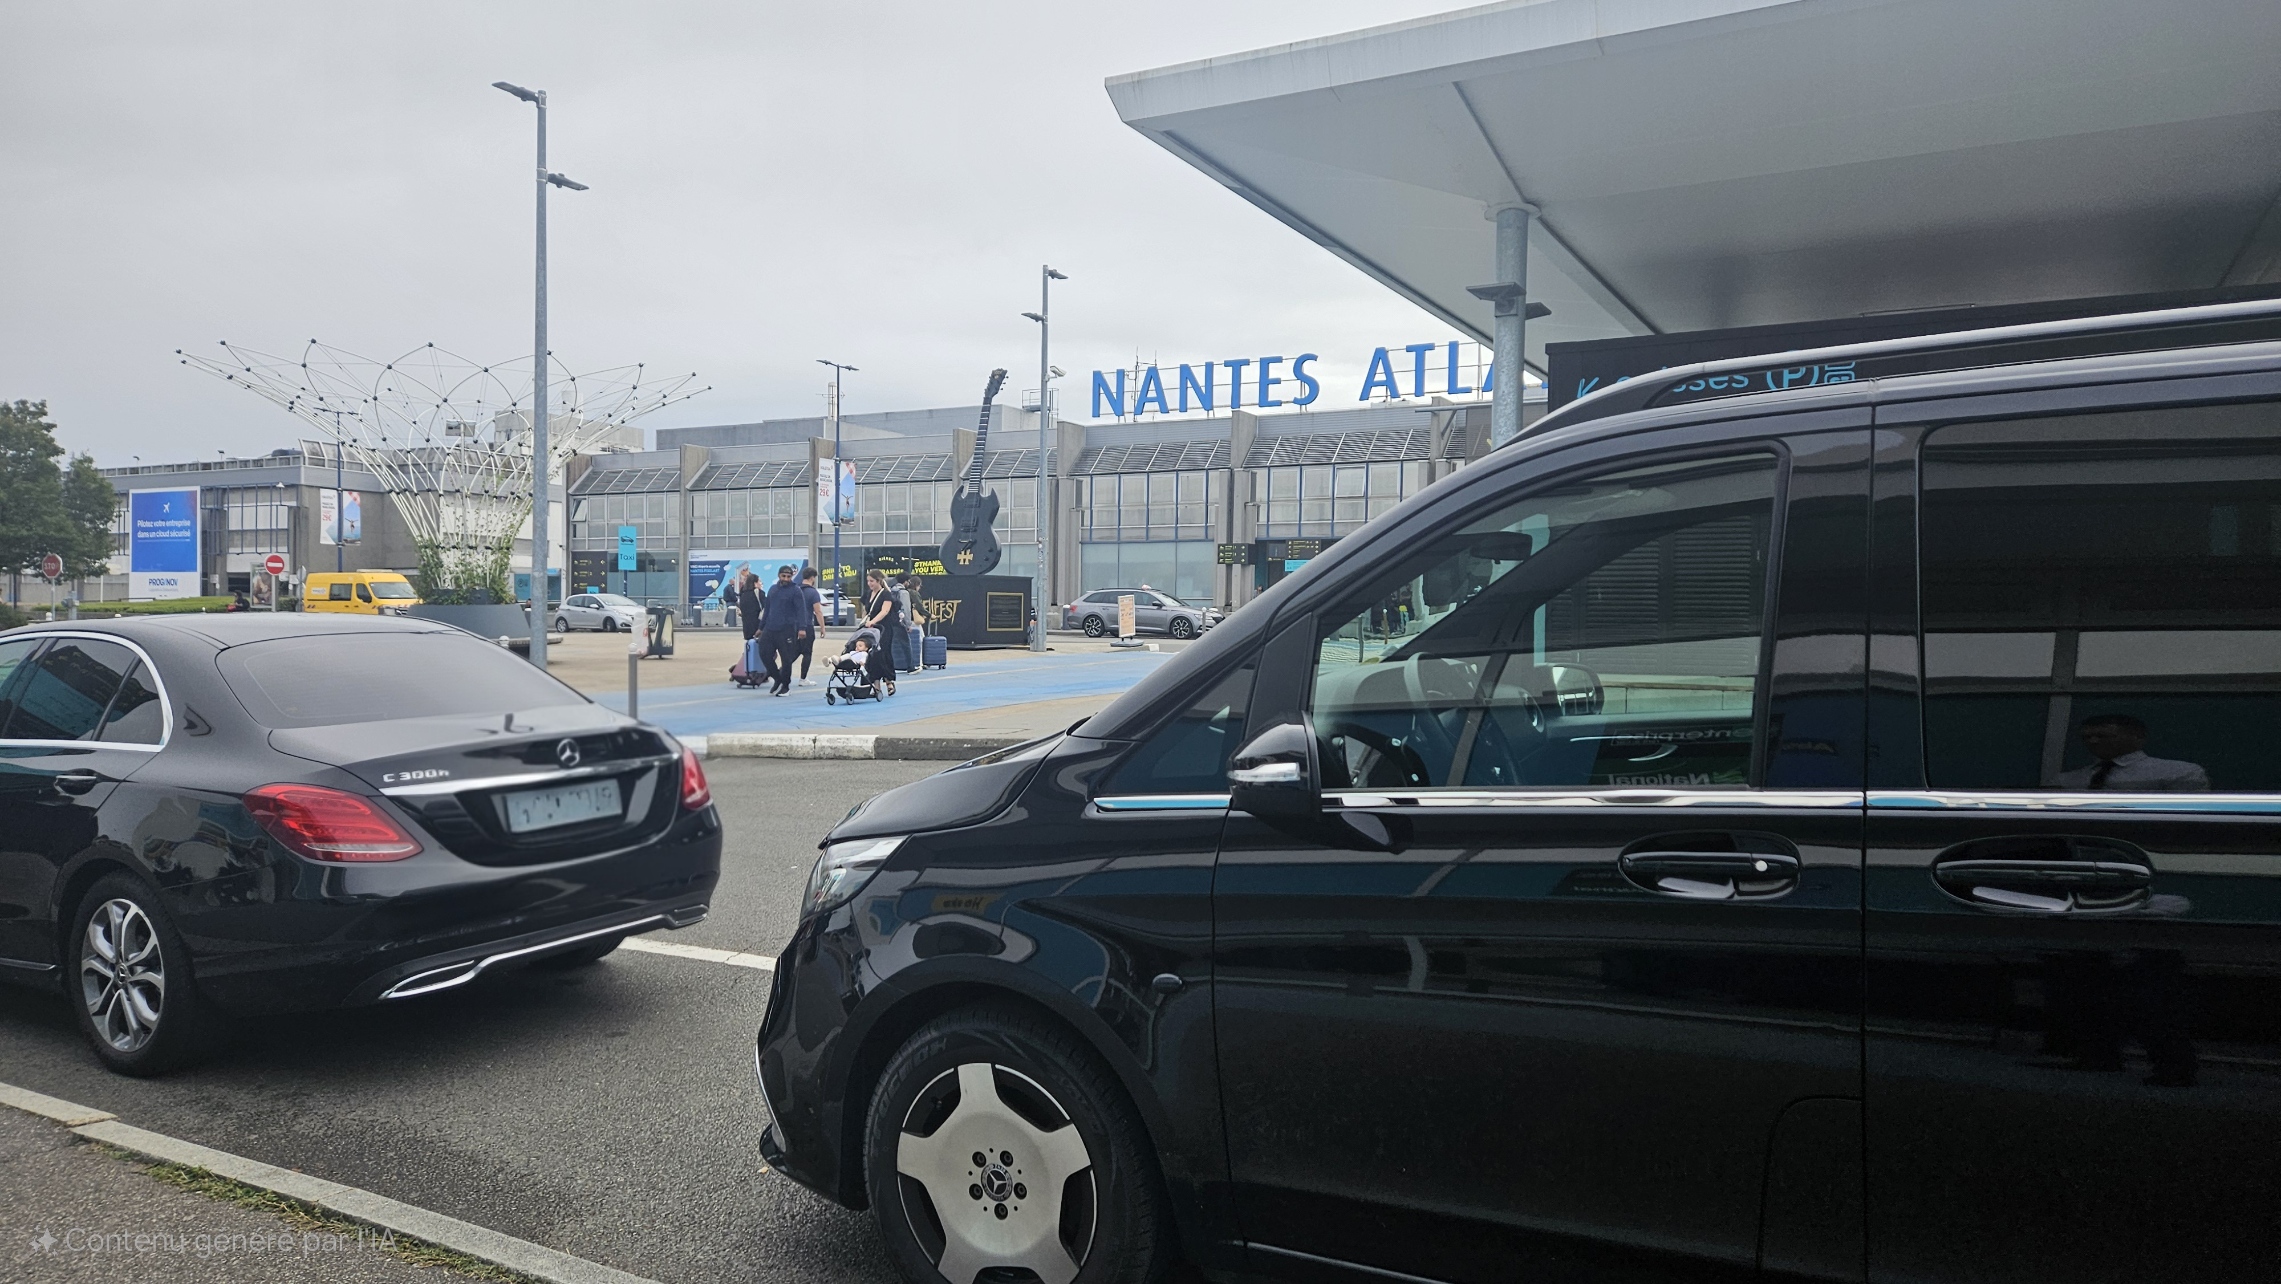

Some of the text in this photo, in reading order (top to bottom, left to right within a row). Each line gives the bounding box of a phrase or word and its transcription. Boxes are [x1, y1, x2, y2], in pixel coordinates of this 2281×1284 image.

[1091, 340, 1494, 418] NANTES ATL
[137, 518, 191, 528] Pilotez votre entreprise
[137, 530, 149, 538] dans
[156, 529, 169, 538] cloud
[169, 529, 191, 537] sécurisé
[44, 562, 59, 570] STO
[843, 569, 857, 577] YOU
[922, 597, 962, 625] ELLFEST
[382, 773, 396, 783] C
